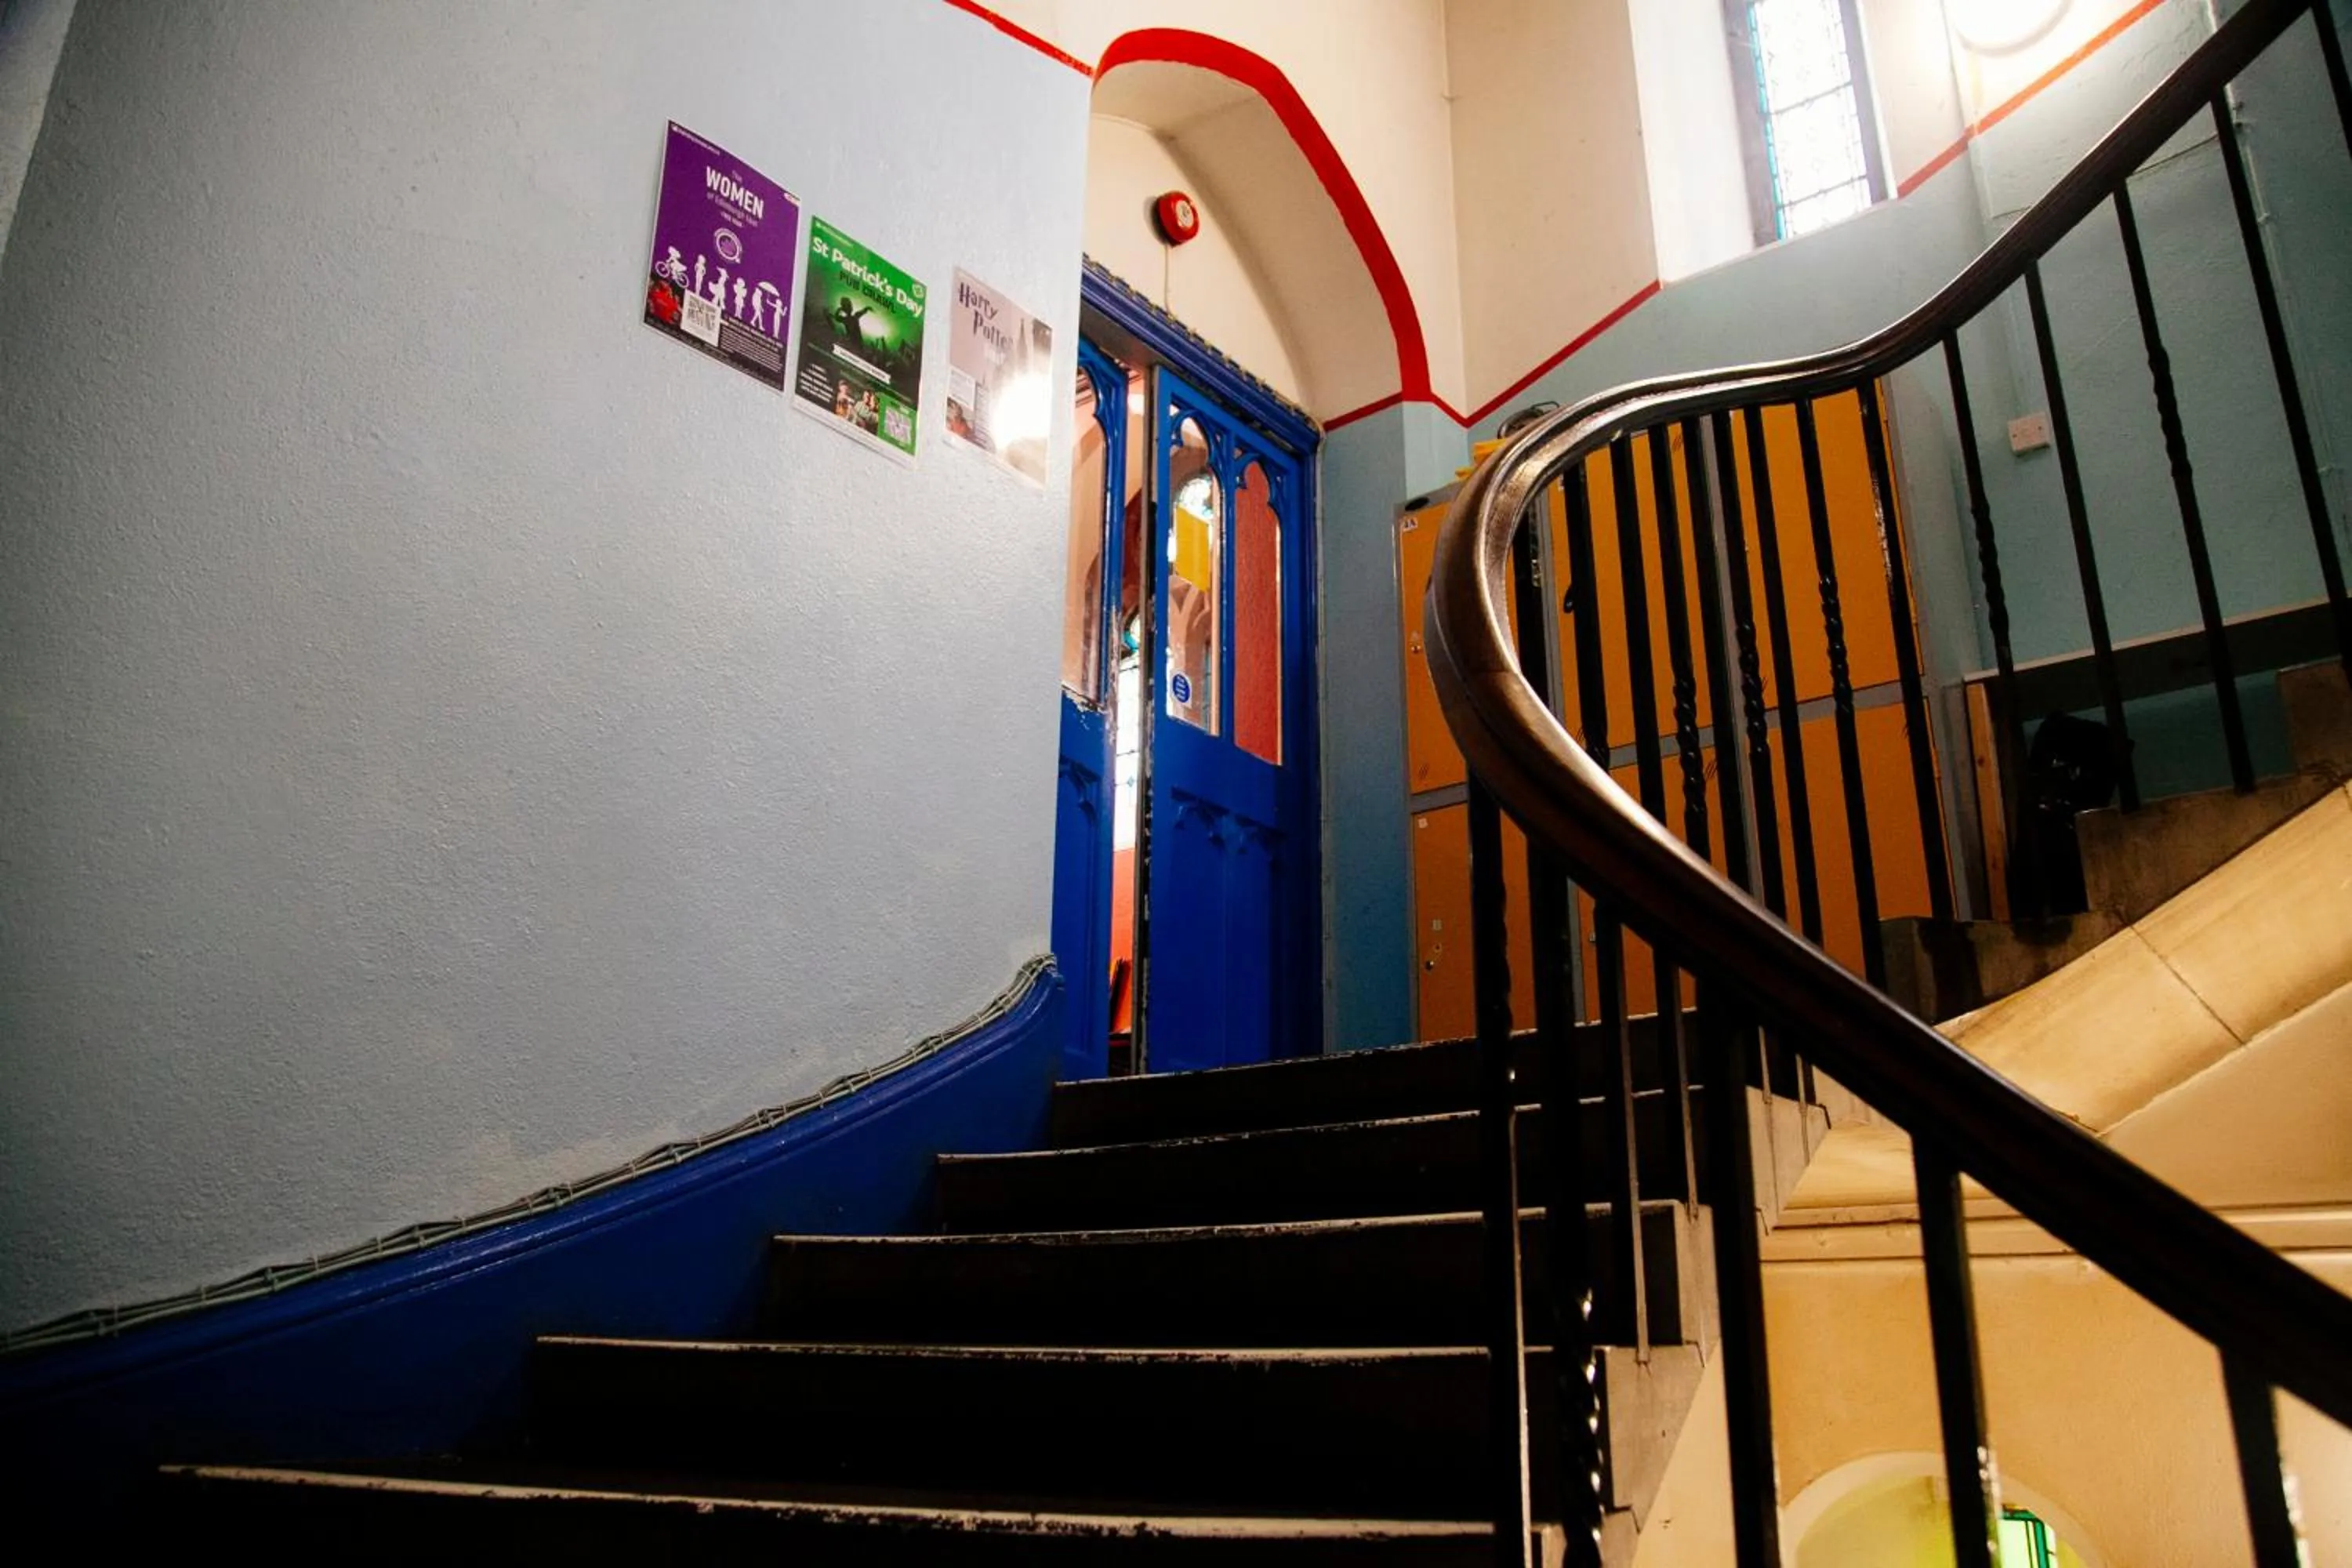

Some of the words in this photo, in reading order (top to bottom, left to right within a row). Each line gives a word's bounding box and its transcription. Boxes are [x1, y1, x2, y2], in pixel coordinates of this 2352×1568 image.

[706, 165, 764, 220] WOMEN
[812, 237, 829, 258] St
[831, 247, 894, 298] Patrick's
[896, 288, 923, 318] Day
[958, 282, 1000, 321] Harry
